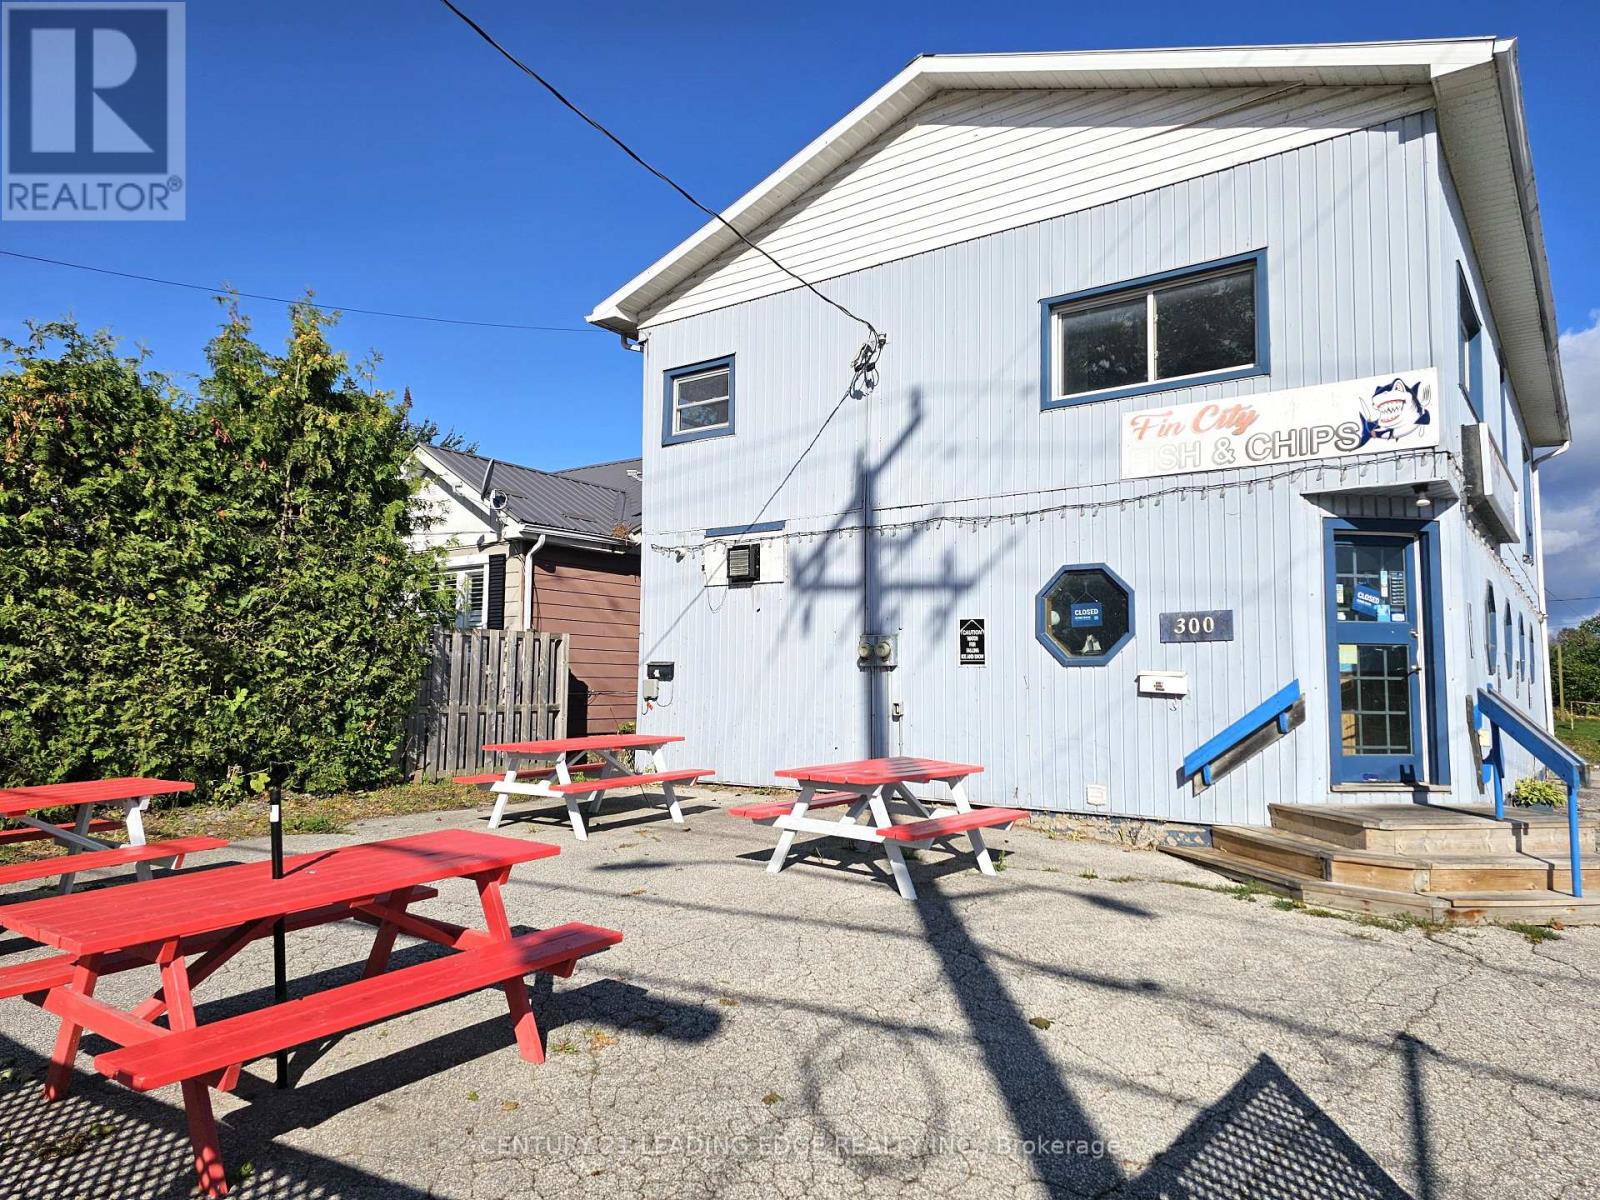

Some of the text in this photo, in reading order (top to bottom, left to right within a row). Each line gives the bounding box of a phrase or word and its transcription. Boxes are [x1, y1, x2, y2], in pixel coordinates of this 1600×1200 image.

[1130, 404, 1259, 440] Fin City
[1211, 436, 1236, 465] &
[1245, 421, 1361, 462] CHIPS
[1074, 608, 1099, 616] CLOSED
[1173, 616, 1216, 634] 300
